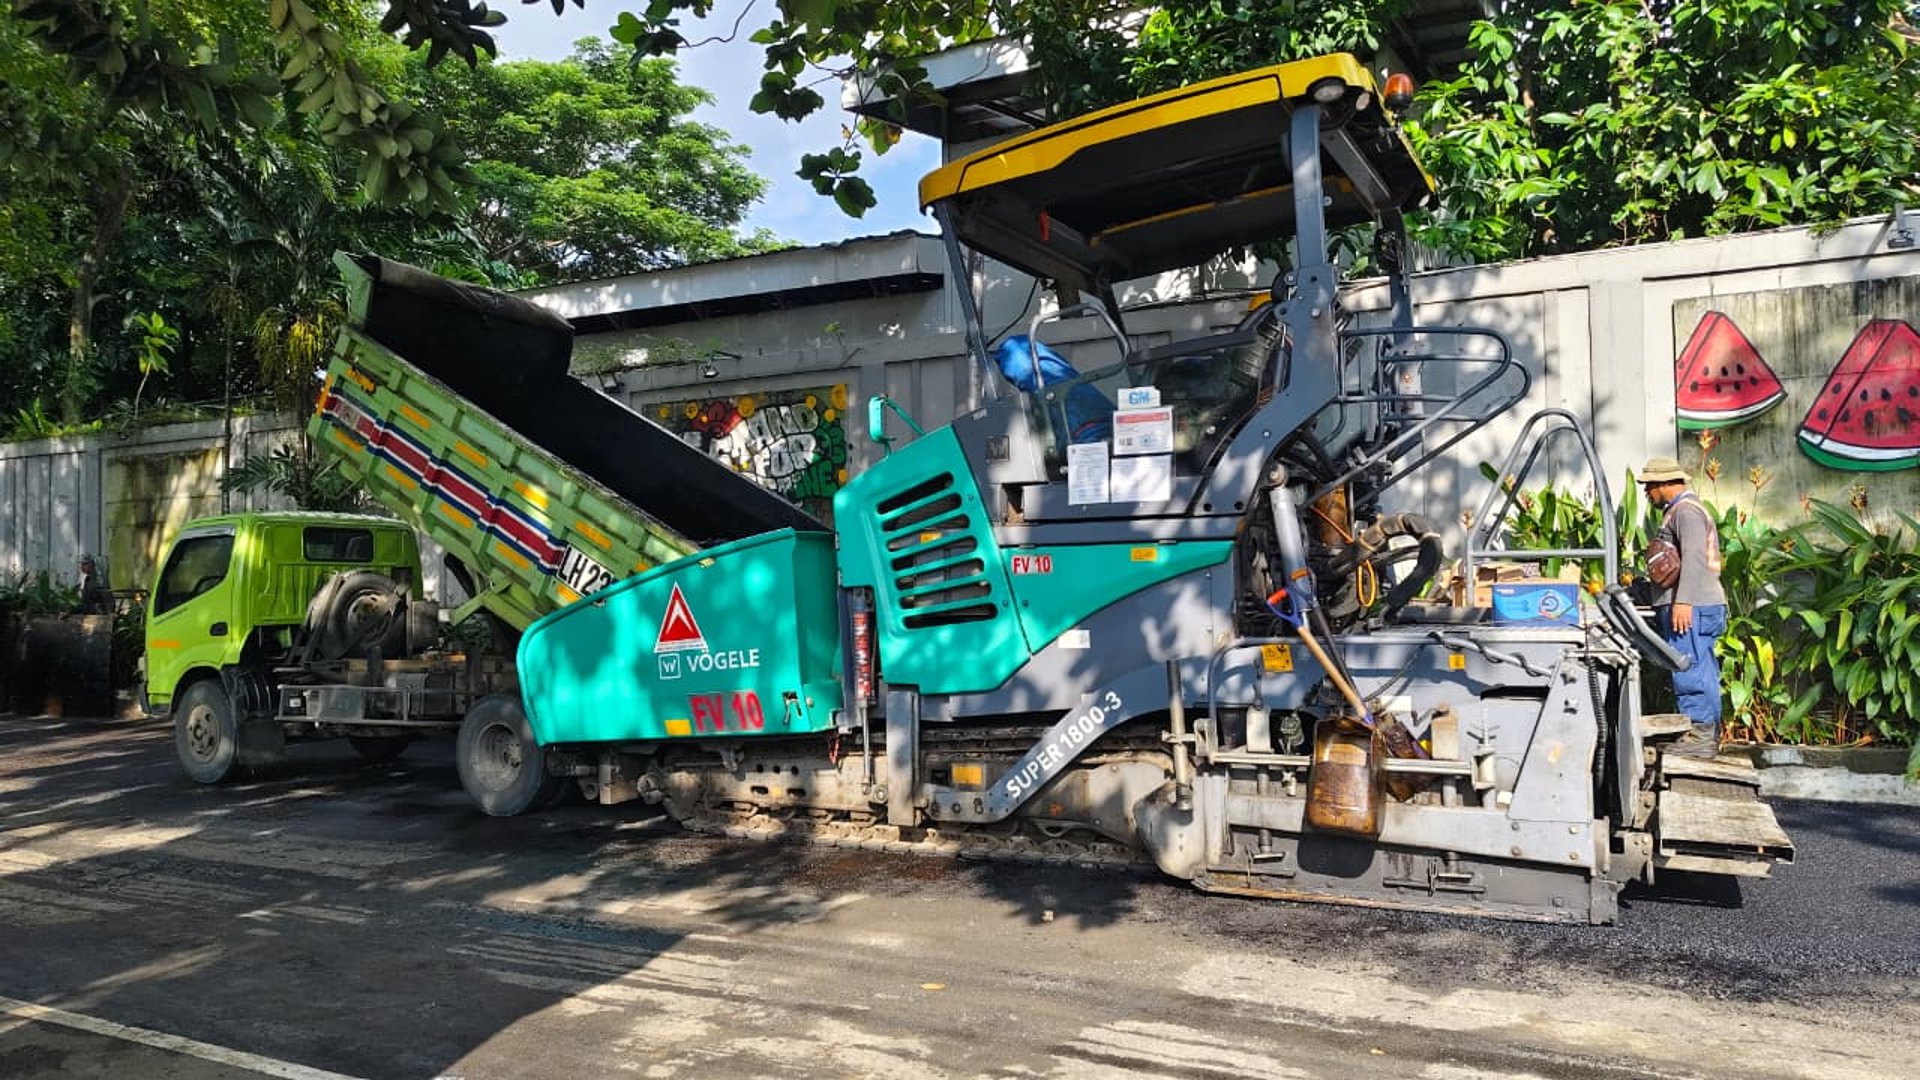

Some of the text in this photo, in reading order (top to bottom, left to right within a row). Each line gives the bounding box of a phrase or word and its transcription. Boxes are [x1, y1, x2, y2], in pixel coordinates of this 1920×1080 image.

[559, 547, 588, 588] LH
[1012, 556, 1051, 574] FV 10
[686, 648, 760, 672] VÖGELE
[690, 691, 765, 732] FV 10
[1006, 691, 1122, 798] SUPER 1800-3
